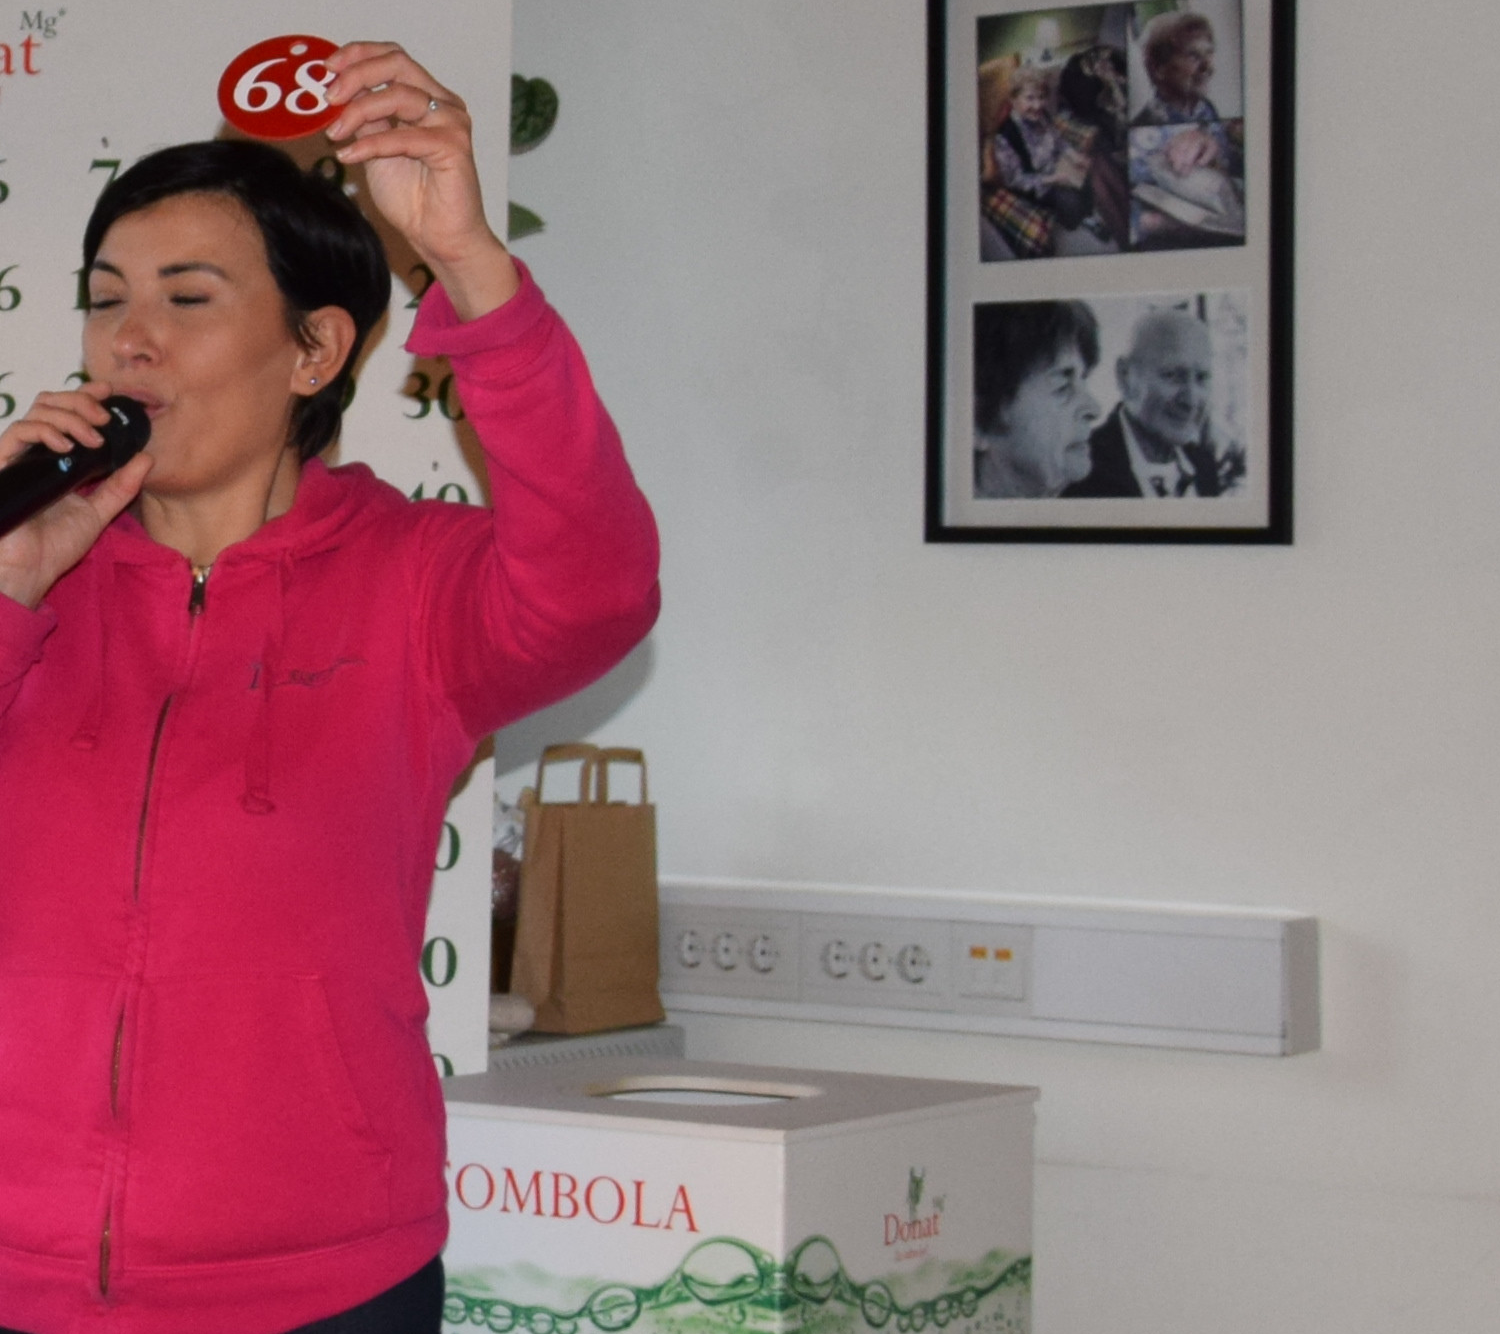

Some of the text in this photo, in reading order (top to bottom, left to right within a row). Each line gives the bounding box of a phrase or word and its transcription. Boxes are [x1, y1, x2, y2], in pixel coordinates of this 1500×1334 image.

[232, 56, 336, 115] 68
[445, 1161, 700, 1234] OMBOLA
[883, 1212, 942, 1247] Donat
